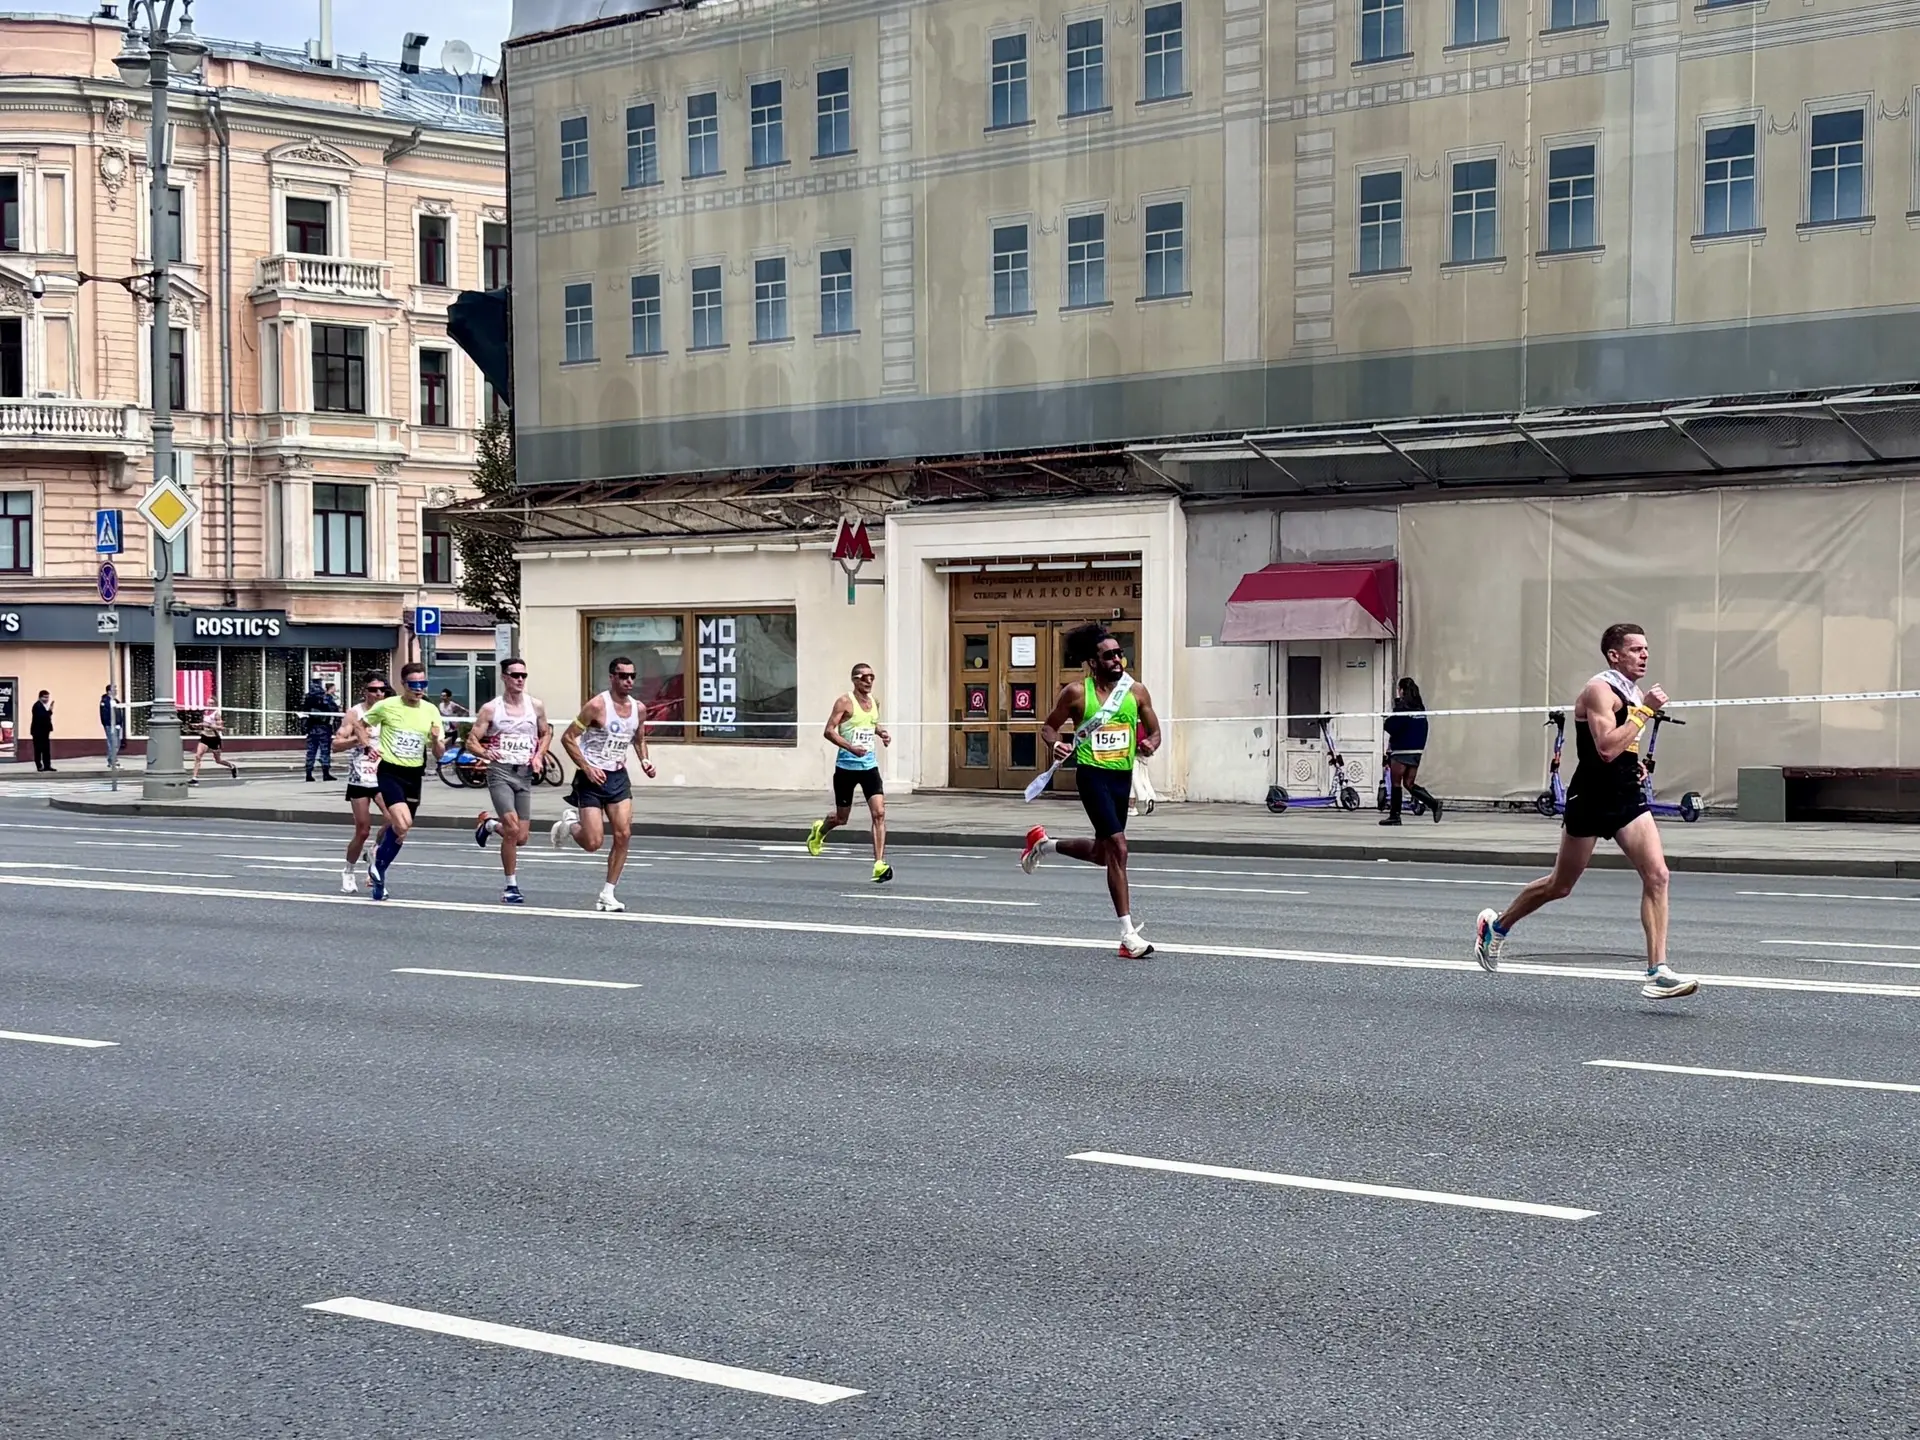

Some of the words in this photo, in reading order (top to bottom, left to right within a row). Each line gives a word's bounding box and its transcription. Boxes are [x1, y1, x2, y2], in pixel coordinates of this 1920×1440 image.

[1012, 585, 1132, 599] МАЯКОВСКАЯ
[195, 617, 280, 636] ROSTIC'S
[421, 609, 436, 632] P
[1095, 732, 1128, 745] 156-1
